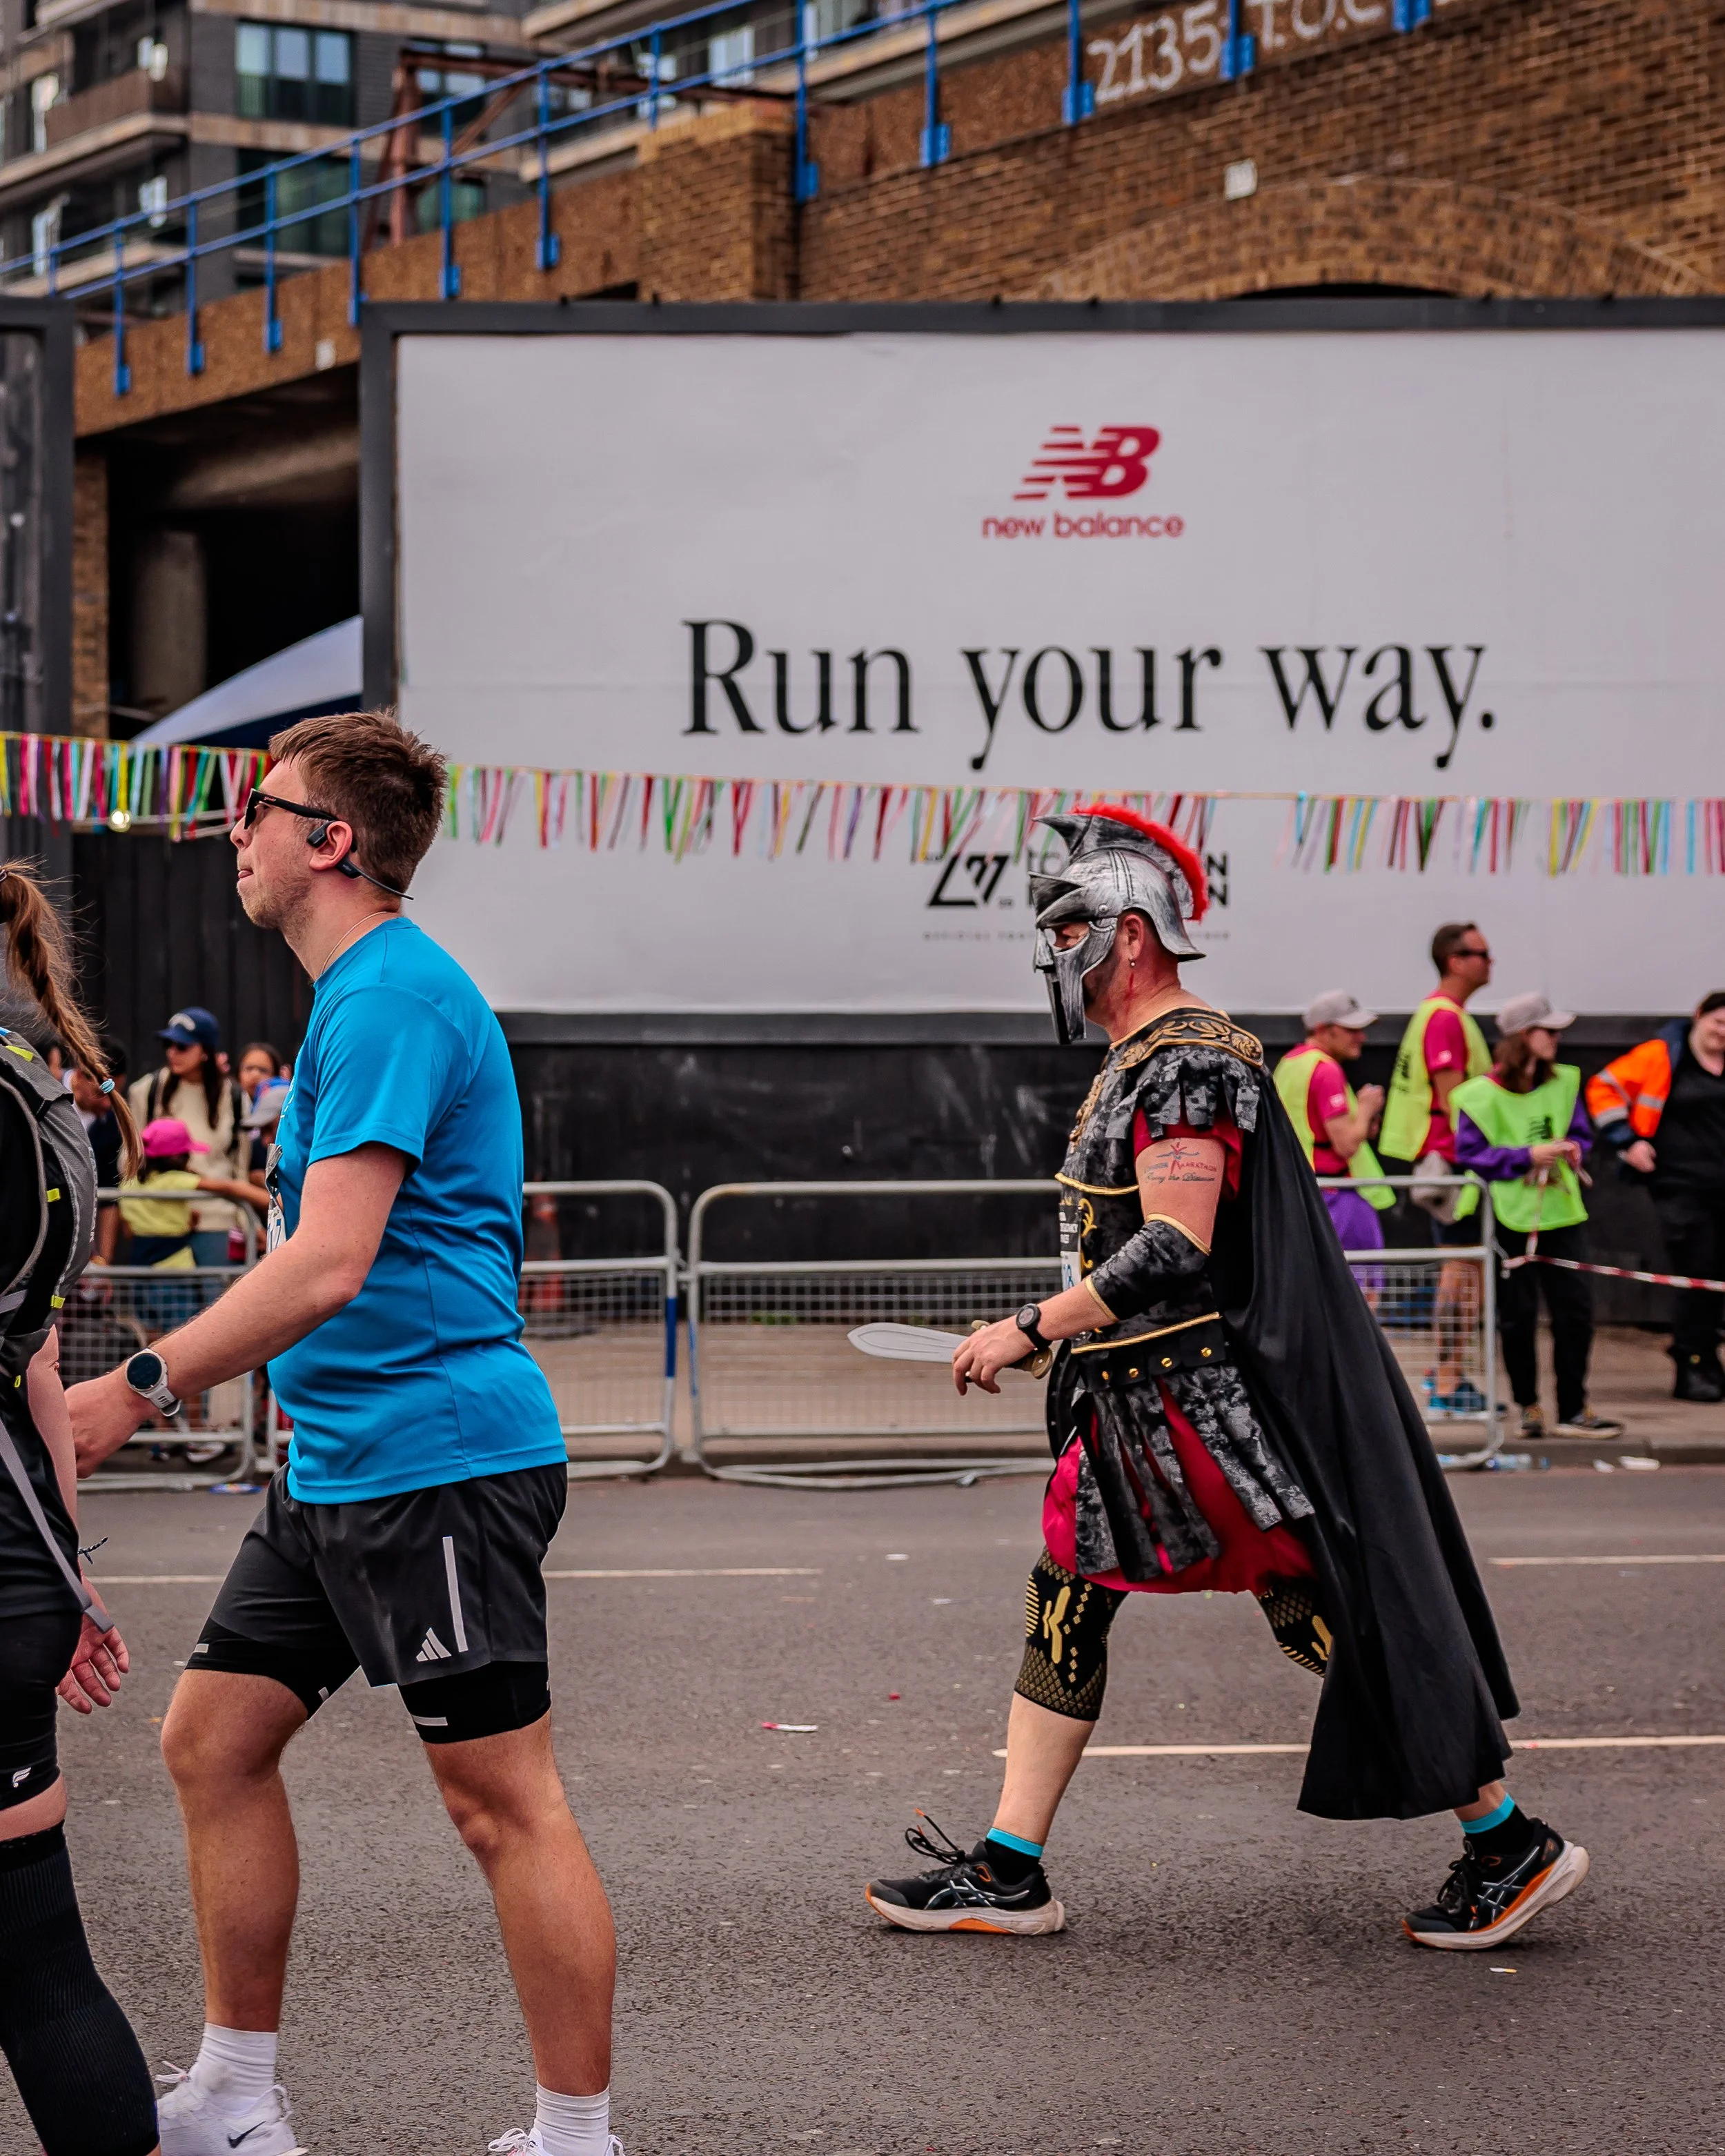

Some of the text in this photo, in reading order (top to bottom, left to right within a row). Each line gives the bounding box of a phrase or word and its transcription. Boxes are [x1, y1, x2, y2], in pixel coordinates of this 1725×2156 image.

[982, 511, 1185, 539] new balance
[682, 620, 1495, 771] Run your way.
